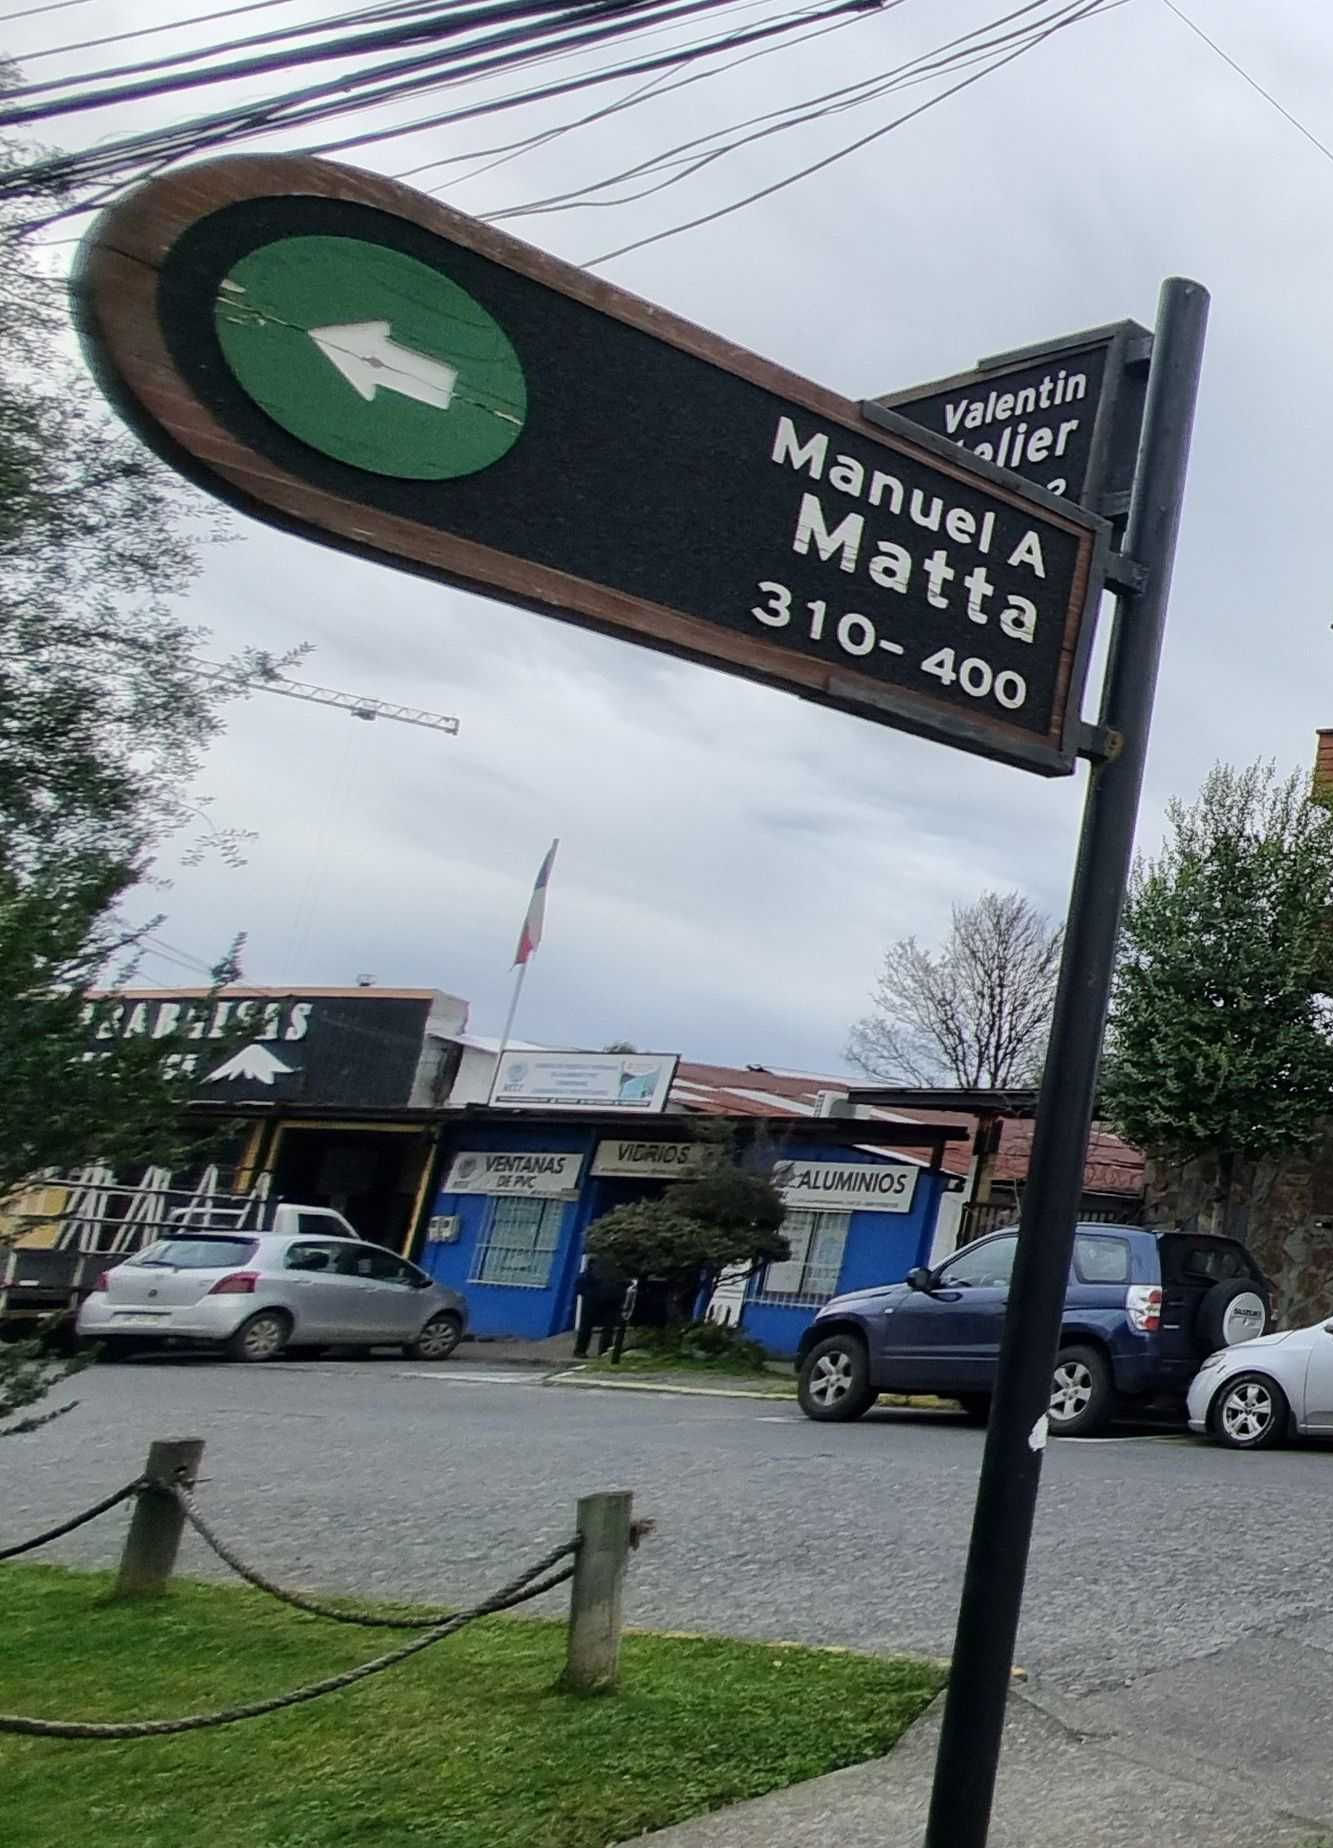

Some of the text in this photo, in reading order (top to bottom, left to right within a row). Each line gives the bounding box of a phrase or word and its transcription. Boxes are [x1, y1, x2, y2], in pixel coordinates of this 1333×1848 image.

[945, 370, 1086, 434] Valentin
[770, 416, 1046, 579] Manuel A
[791, 492, 1038, 645] Matta
[921, 647, 1027, 710] 400
[485, 1154, 567, 1175] VENTANAS
[617, 1143, 692, 1165] VIDRIOS
[496, 1174, 537, 1189] DE PVC
[798, 1169, 908, 1195] ALUMINIOS
